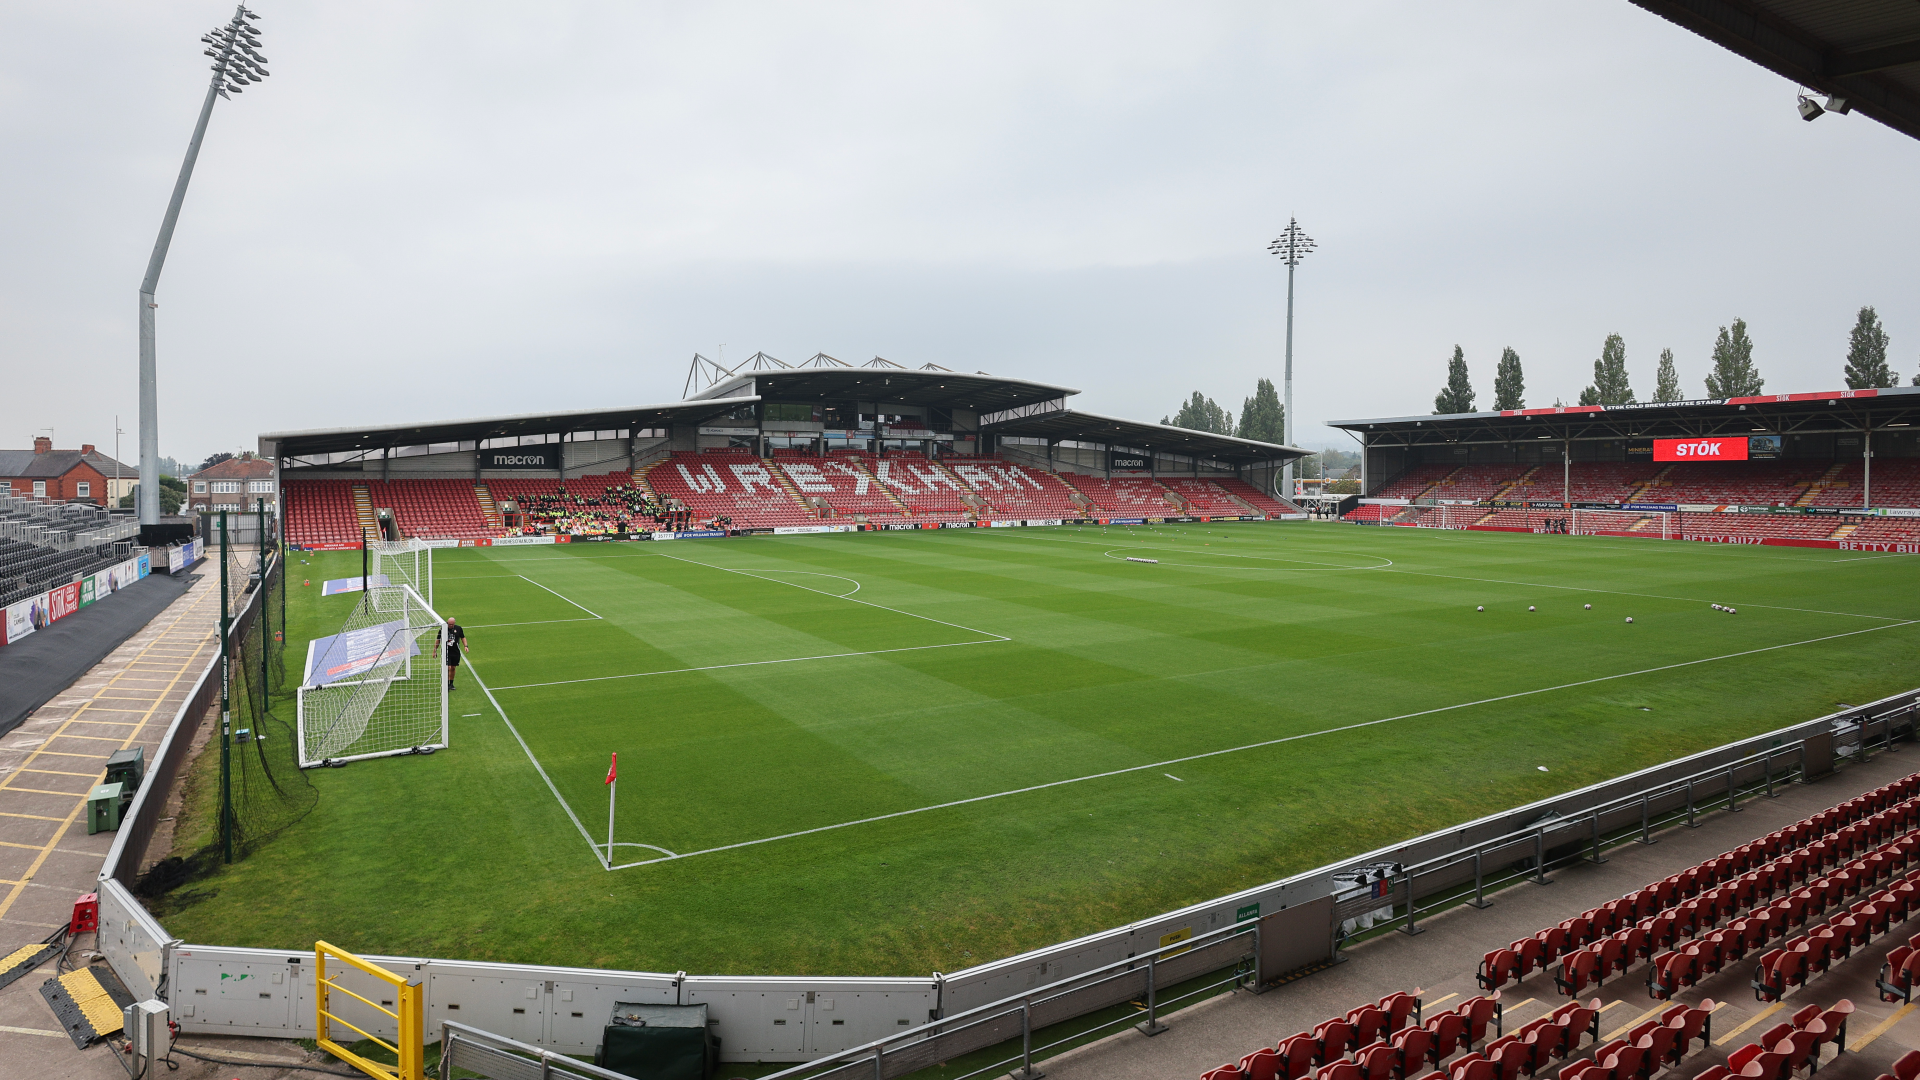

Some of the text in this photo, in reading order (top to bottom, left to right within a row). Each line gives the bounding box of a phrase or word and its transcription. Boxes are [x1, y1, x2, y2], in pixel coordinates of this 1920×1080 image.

[493, 455, 545, 465] macron
[1114, 459, 1144, 467] macron
[945, 521, 970, 529] macron
[1683, 534, 1725, 543] BETTY
[1839, 541, 1920, 554] BETTY BU
